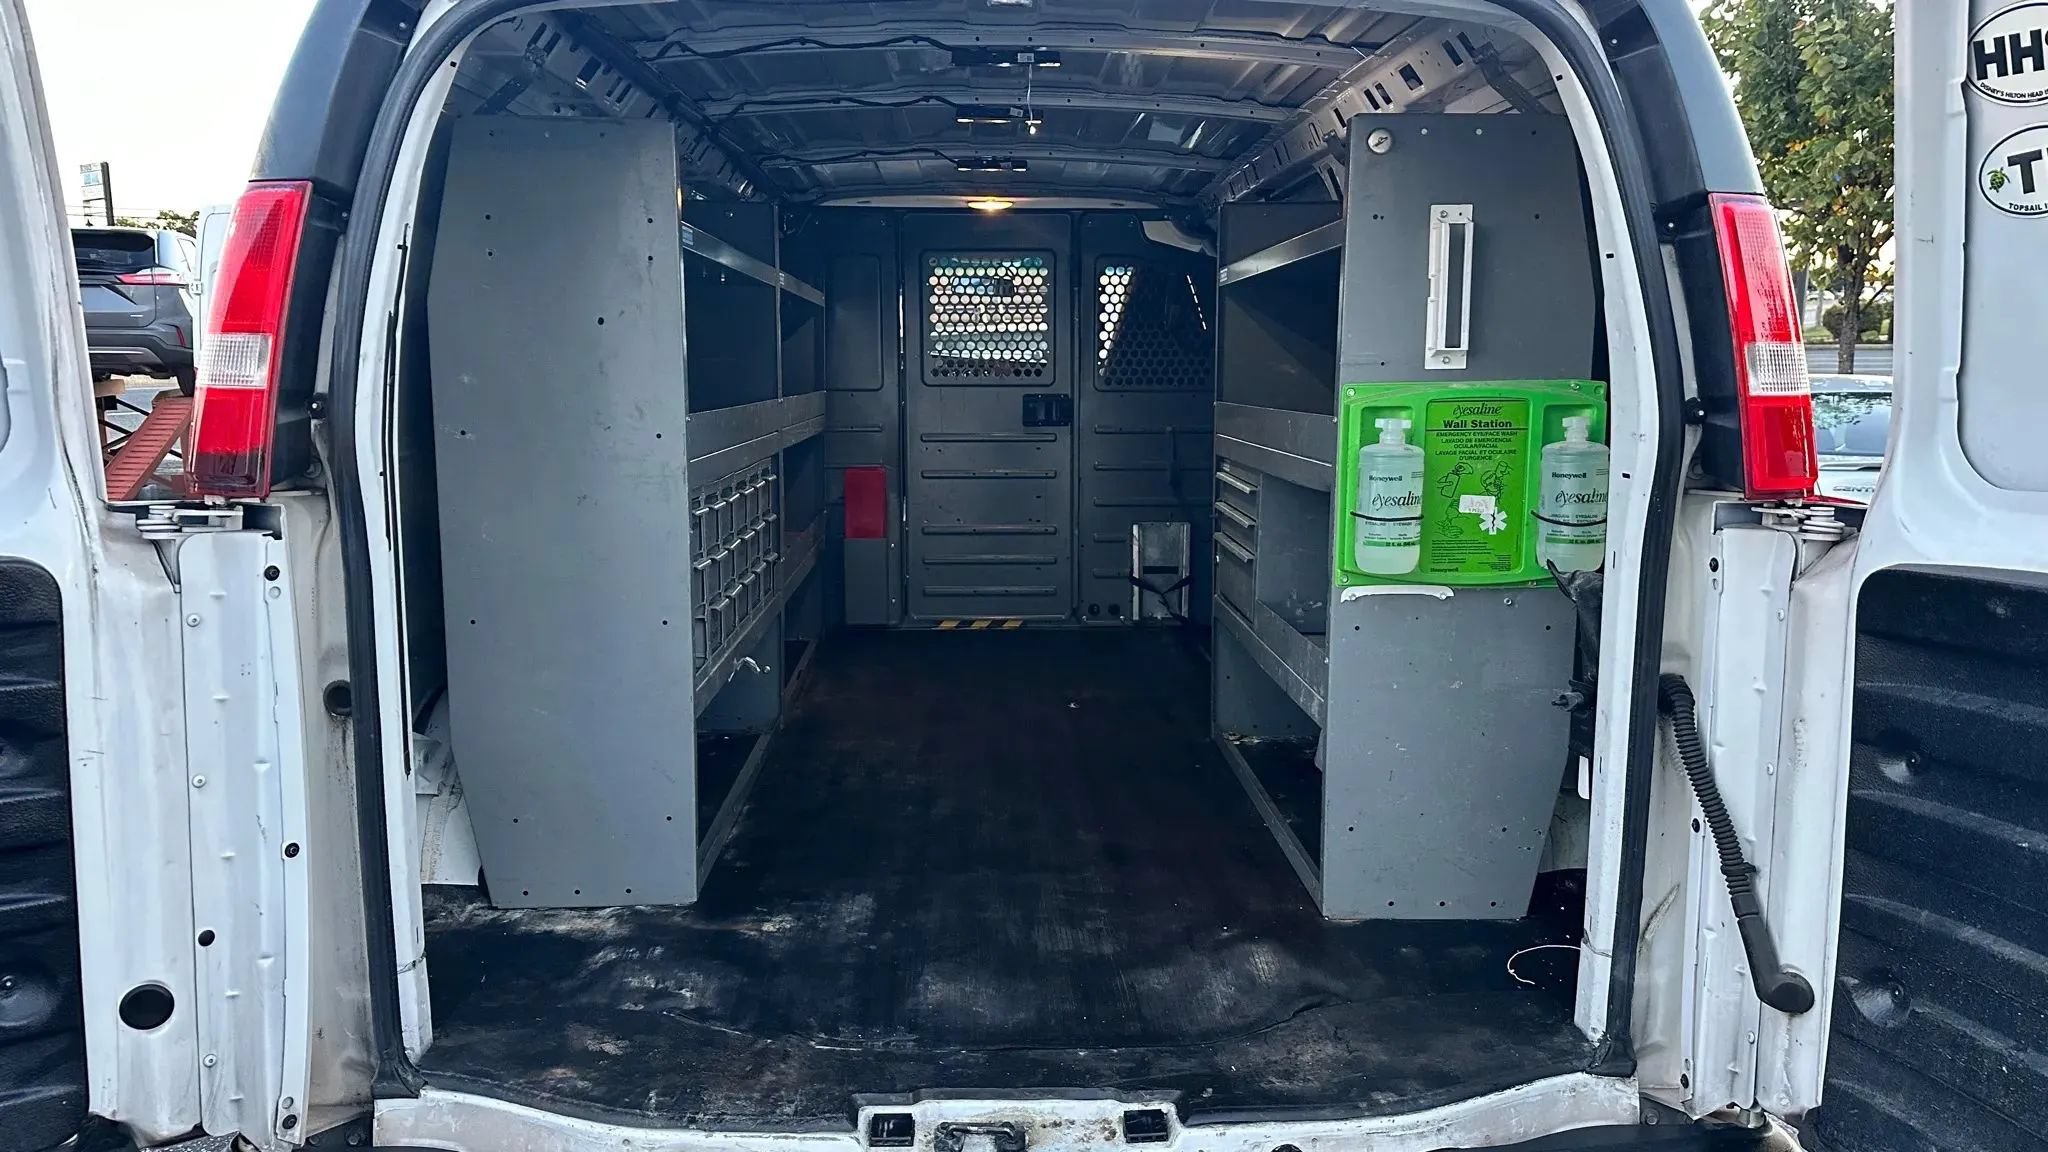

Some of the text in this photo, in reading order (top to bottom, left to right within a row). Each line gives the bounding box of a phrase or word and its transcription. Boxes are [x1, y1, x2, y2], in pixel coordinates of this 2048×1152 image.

[1973, 28, 2048, 81] HH
[1980, 82, 2004, 97] DISNEY'S
[2008, 202, 2042, 211] TOPSAIL
[1453, 402, 1503, 418] eyesaline
[1443, 419, 1513, 429] Wall Station
[1552, 471, 1587, 479] Honeywell
